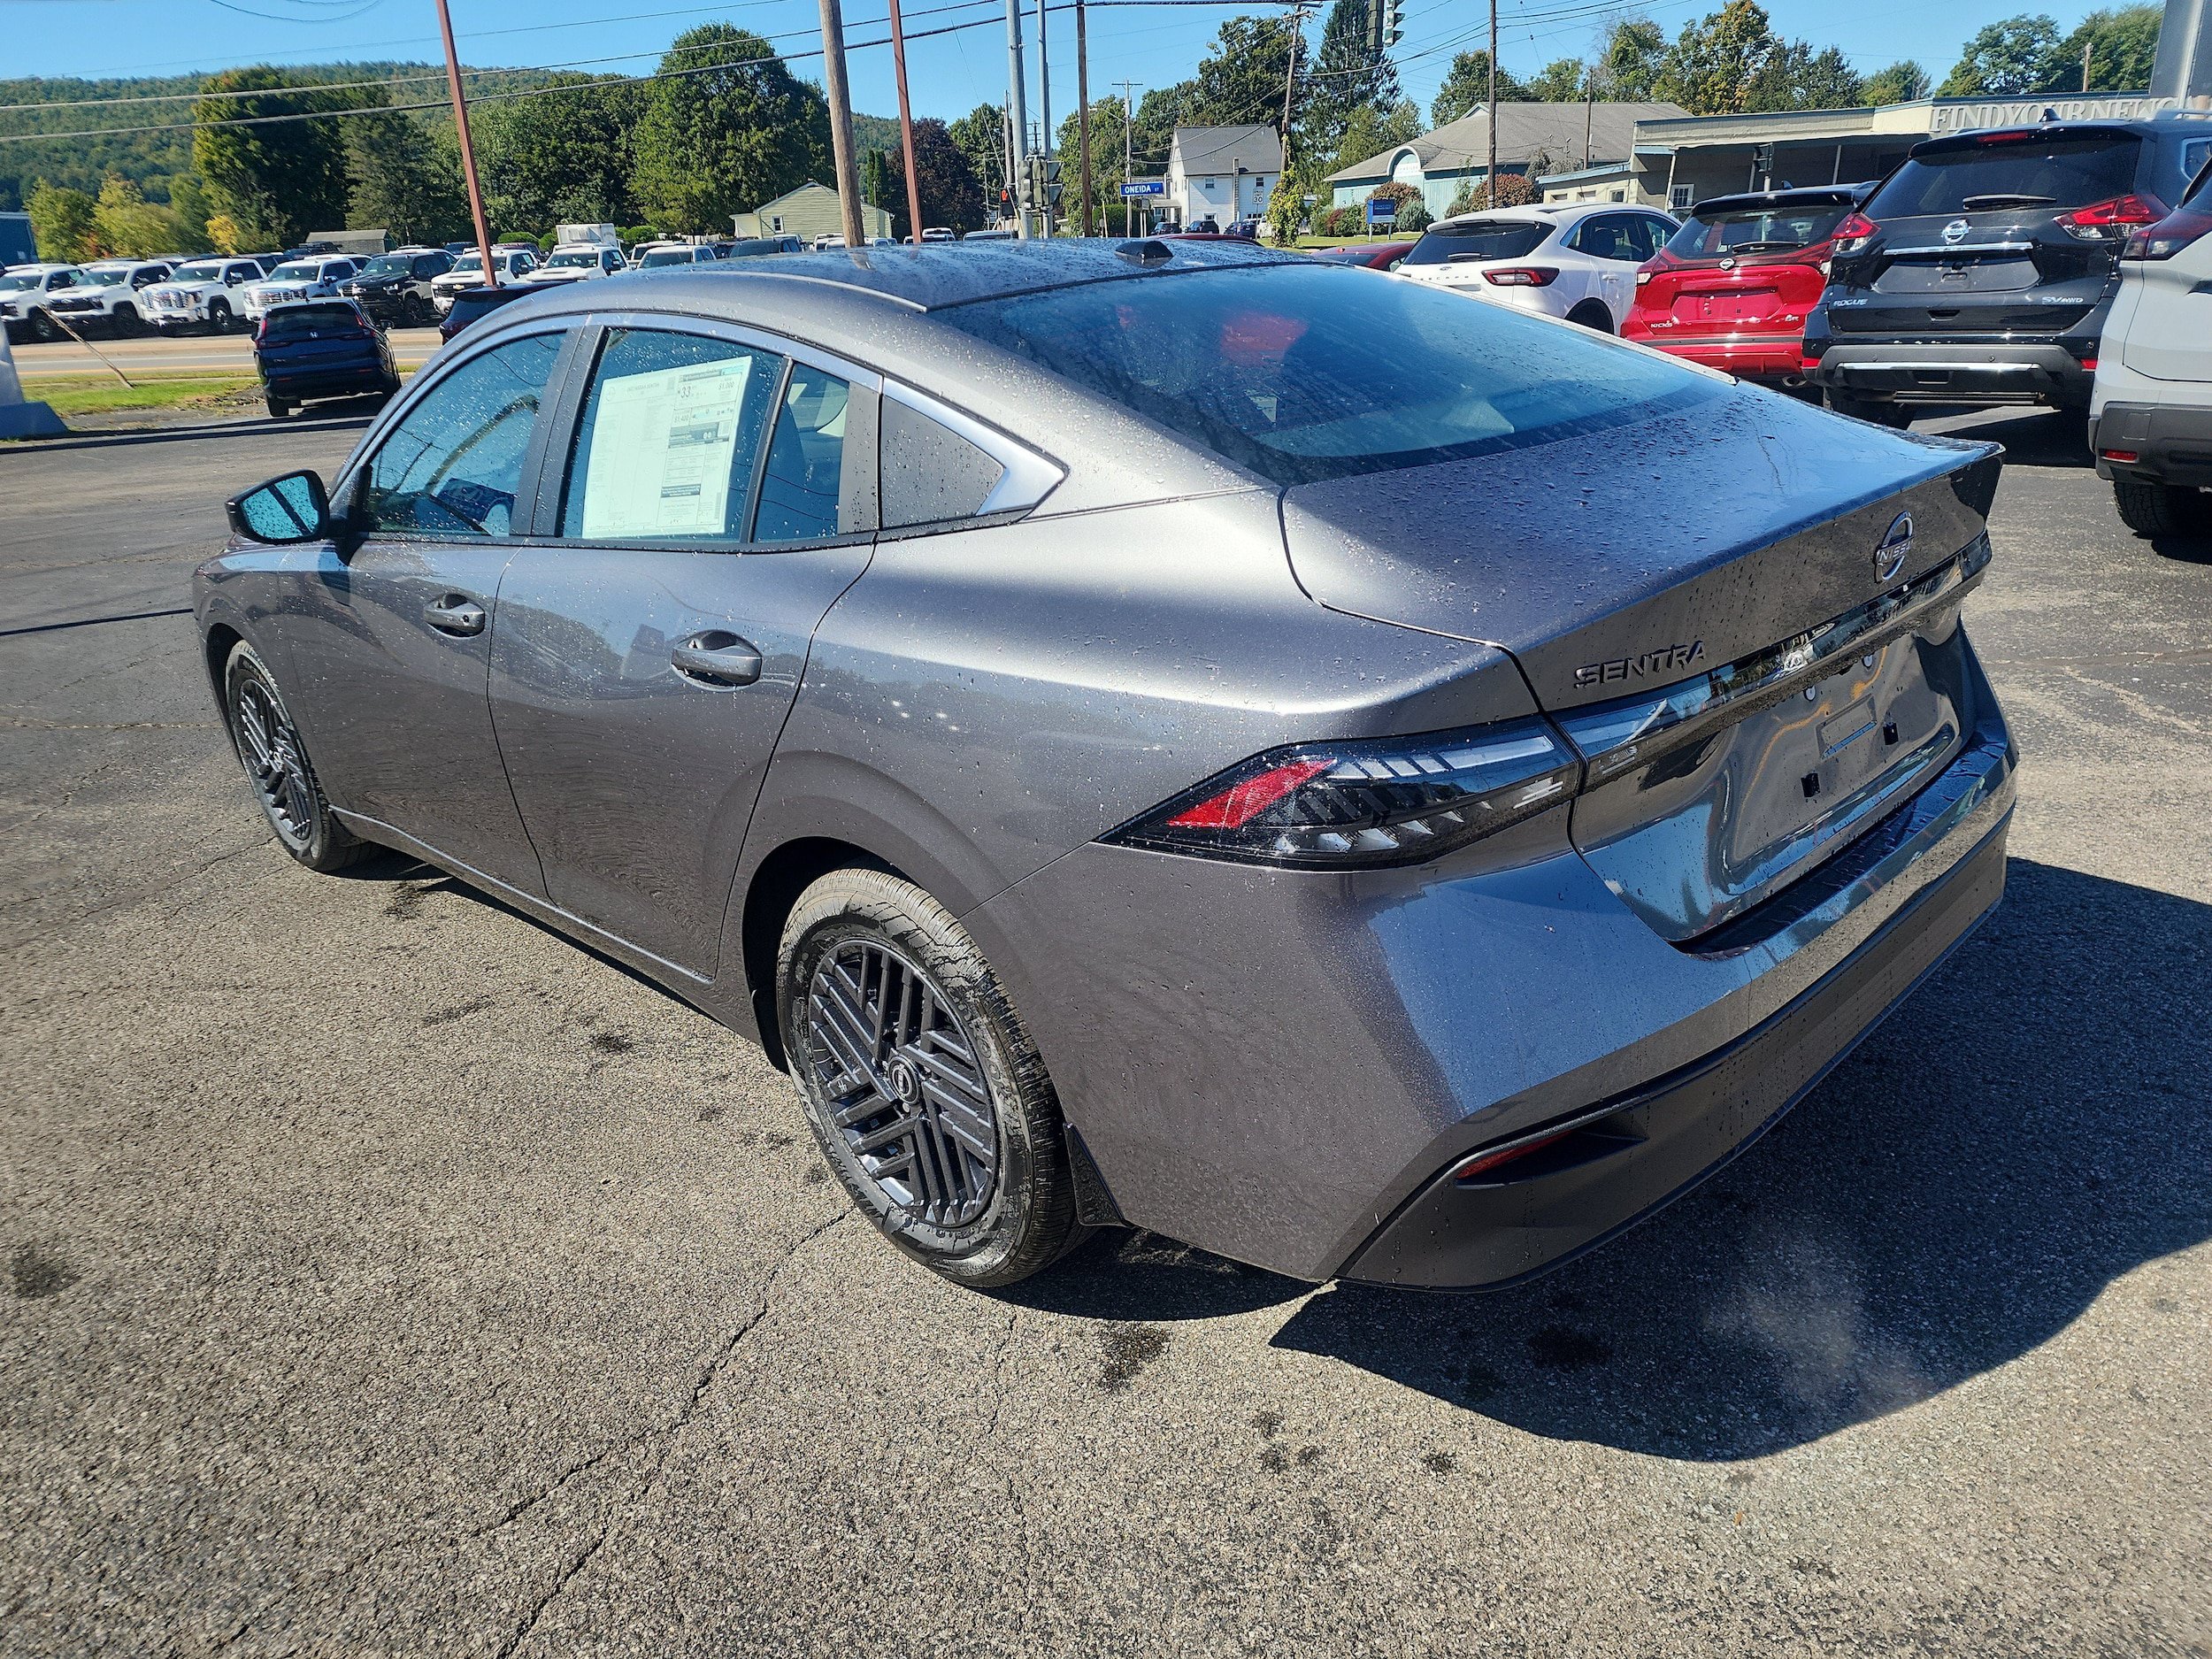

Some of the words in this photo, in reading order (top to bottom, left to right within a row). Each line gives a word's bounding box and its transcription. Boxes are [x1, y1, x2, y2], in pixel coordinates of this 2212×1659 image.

[1929, 104, 2006, 132] FIND
[1124, 185, 1151, 194] ONEIDA
[1833, 298, 1869, 307] ROGUE
[1878, 540, 1914, 563] NISSA
[1573, 640, 1706, 689] SENTRA
